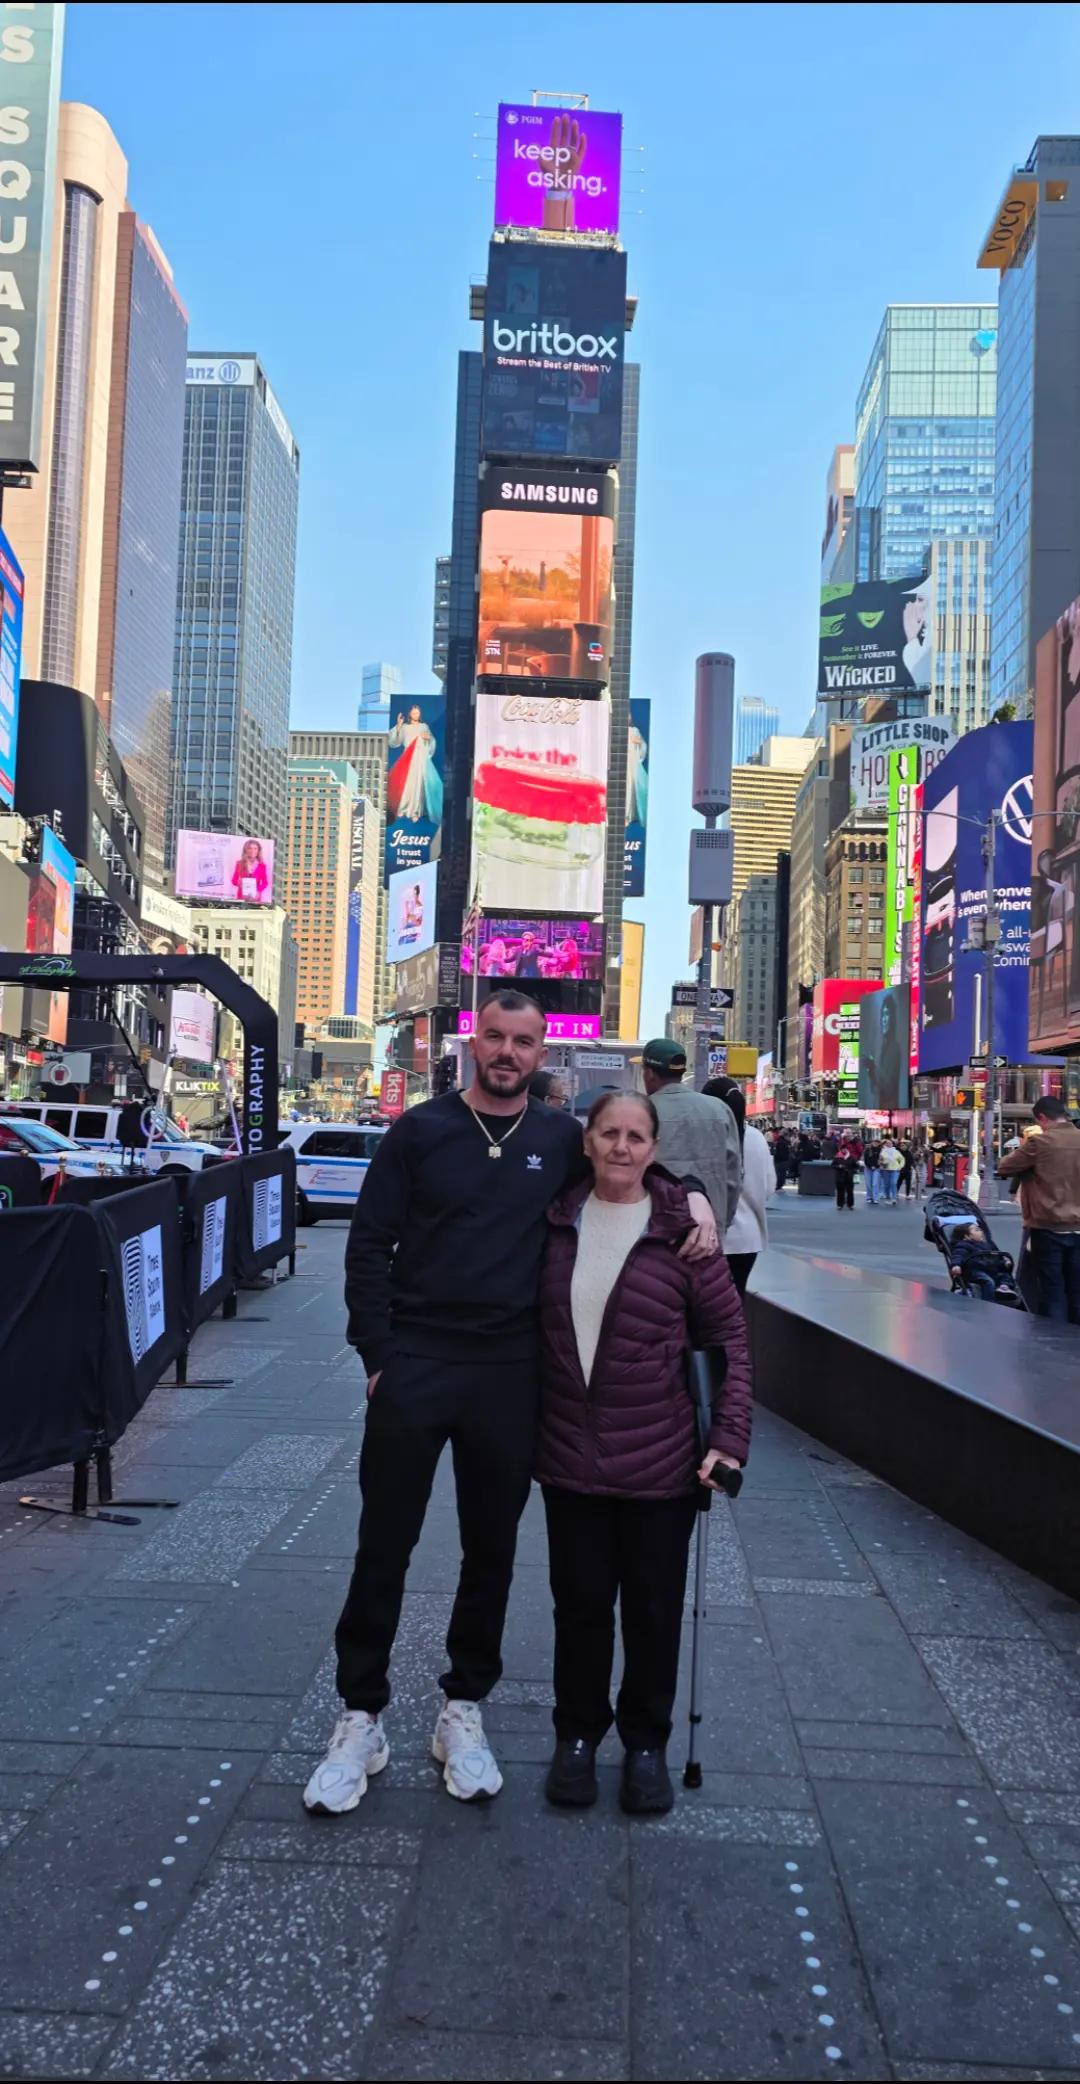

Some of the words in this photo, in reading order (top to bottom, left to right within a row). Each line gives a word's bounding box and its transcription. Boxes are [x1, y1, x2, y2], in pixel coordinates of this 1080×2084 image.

[514, 138, 571, 167] keep
[527, 168, 607, 197] asking.
[0, 106, 31, 422] SQUARE
[493, 319, 617, 359] britbox
[497, 356, 526, 366] Stream
[528, 359, 541, 368] the
[543, 361, 561, 369] Best
[573, 363, 599, 372] British
[600, 365, 611, 373] TV
[501, 482, 598, 505] SAMSUNG
[862, 723, 910, 753] LITTLE
[913, 723, 949, 745] SHOP
[389, 829, 431, 847] Jesus
[401, 849, 422, 857] trust
[406, 859, 422, 867] you
[895, 783, 908, 953] CANNABIS
[961, 890, 988, 903] When
[572, 1023, 593, 1035] IN
[176, 1081, 220, 1092] KLIKTIX
[387, 1073, 402, 1104] tkts
